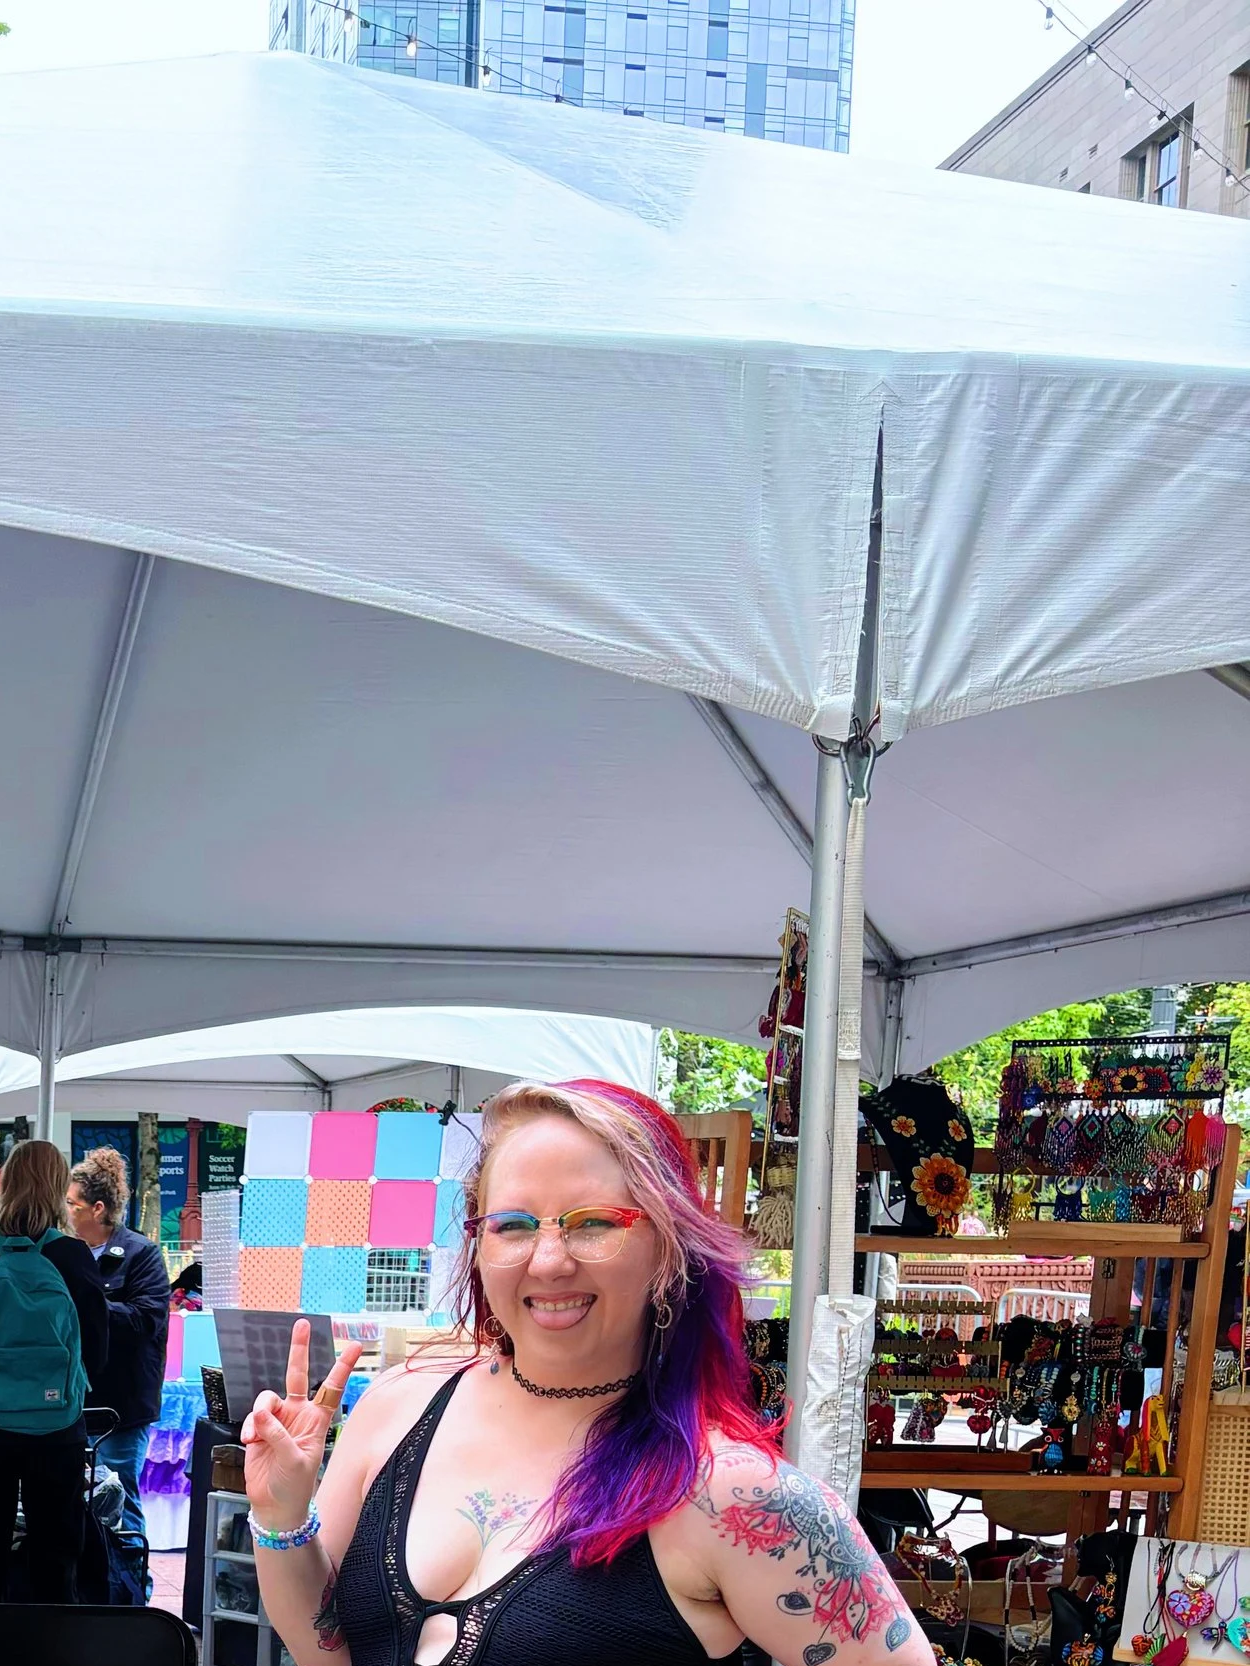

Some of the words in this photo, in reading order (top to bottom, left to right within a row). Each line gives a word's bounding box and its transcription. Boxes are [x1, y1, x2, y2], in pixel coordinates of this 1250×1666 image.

[208, 1154, 236, 1163] Soccer
[158, 1166, 184, 1177] ports
[208, 1164, 235, 1173] Watch
[208, 1174, 237, 1183] Parties
